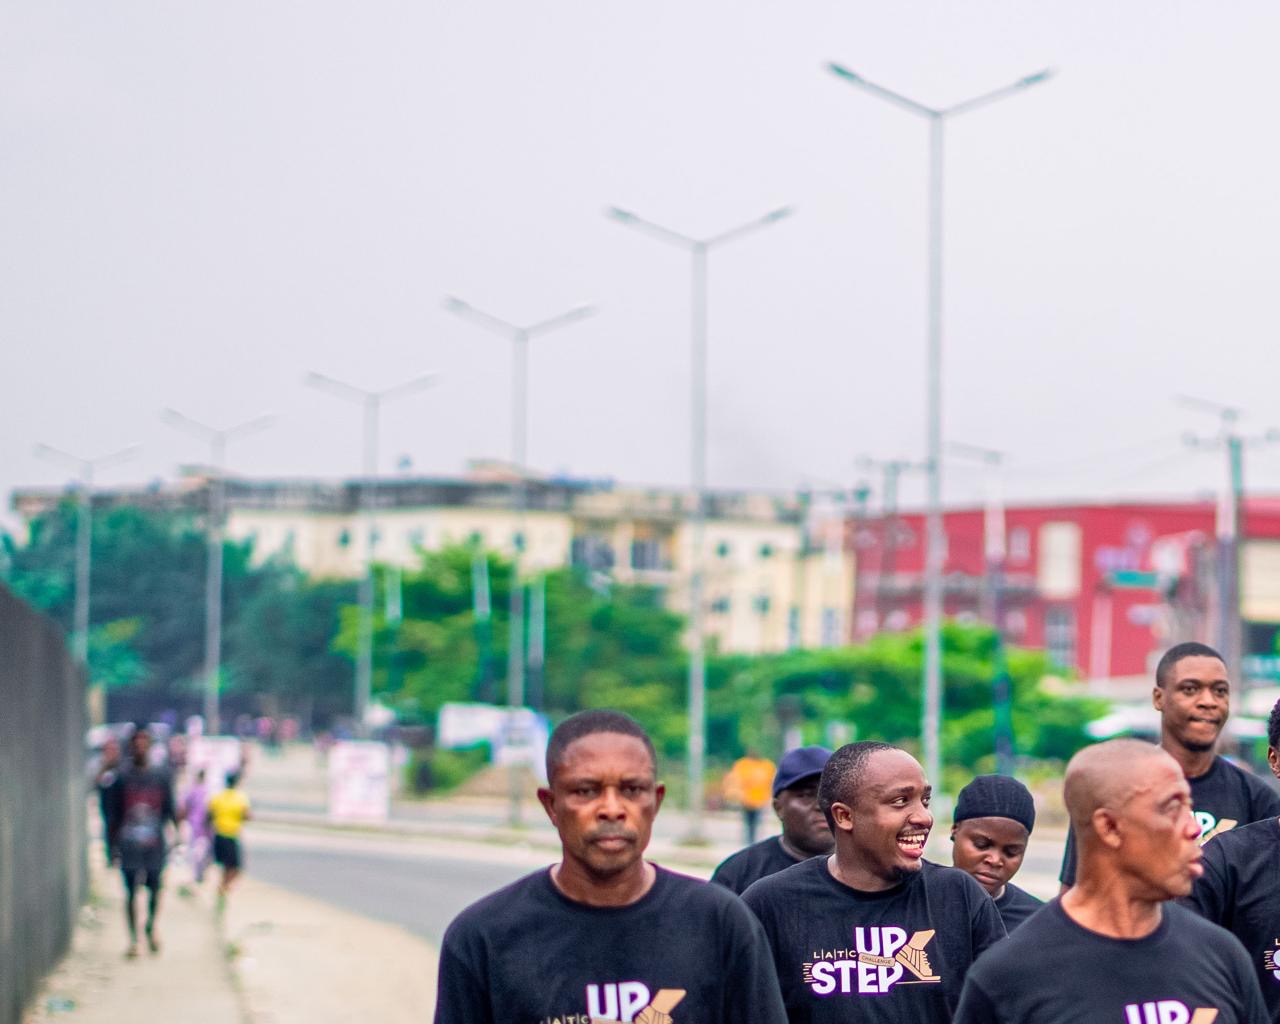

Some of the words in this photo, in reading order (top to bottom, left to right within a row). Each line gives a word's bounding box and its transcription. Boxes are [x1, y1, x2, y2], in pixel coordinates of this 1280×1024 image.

[855, 926, 907, 958] UP
[811, 960, 903, 994] STEP
[586, 981, 650, 1023] UP
